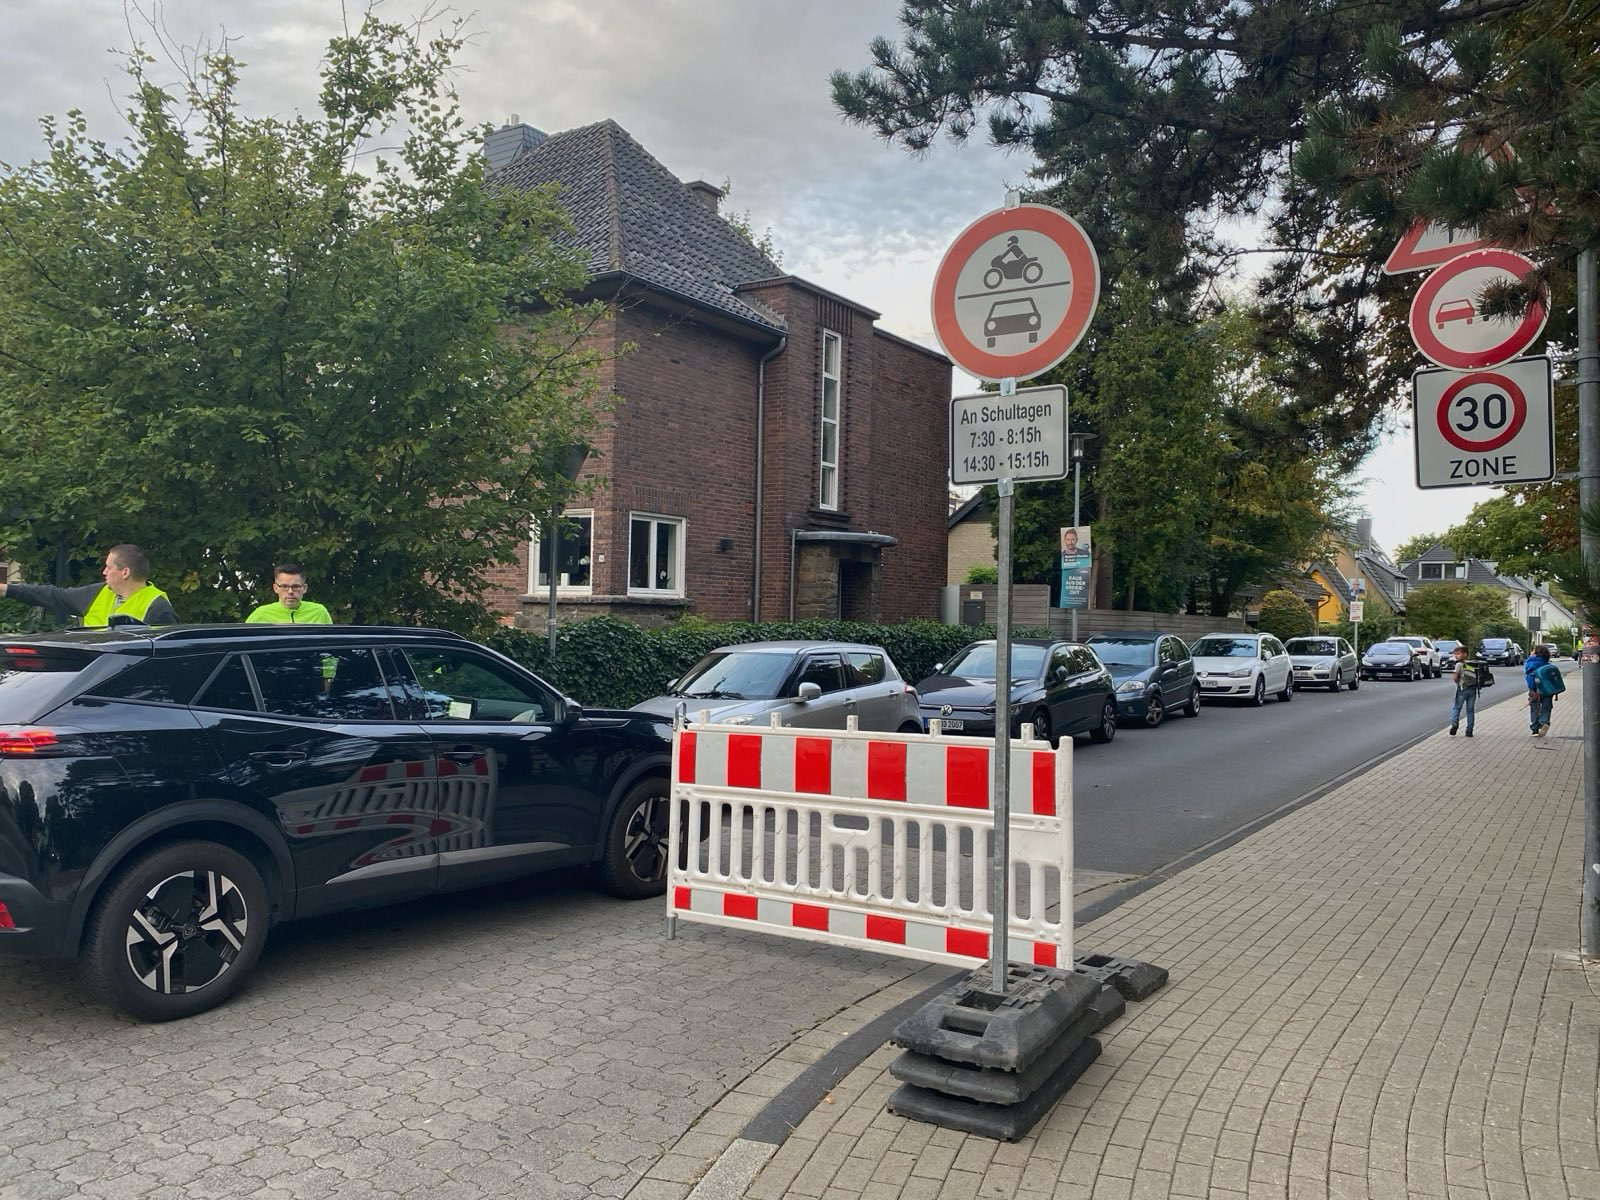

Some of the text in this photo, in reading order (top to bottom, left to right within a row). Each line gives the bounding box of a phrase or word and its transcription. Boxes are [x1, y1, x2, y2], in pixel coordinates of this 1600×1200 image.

[960, 403, 1052, 425] An Schultagen
[1455, 393, 1507, 432] 30
[970, 430, 995, 448] 7:30
[1007, 426, 1041, 445] 8:15h
[963, 455, 995, 473] 14:30
[1007, 450, 1049, 469] 15:15h
[1449, 455, 1517, 479] ZONE
